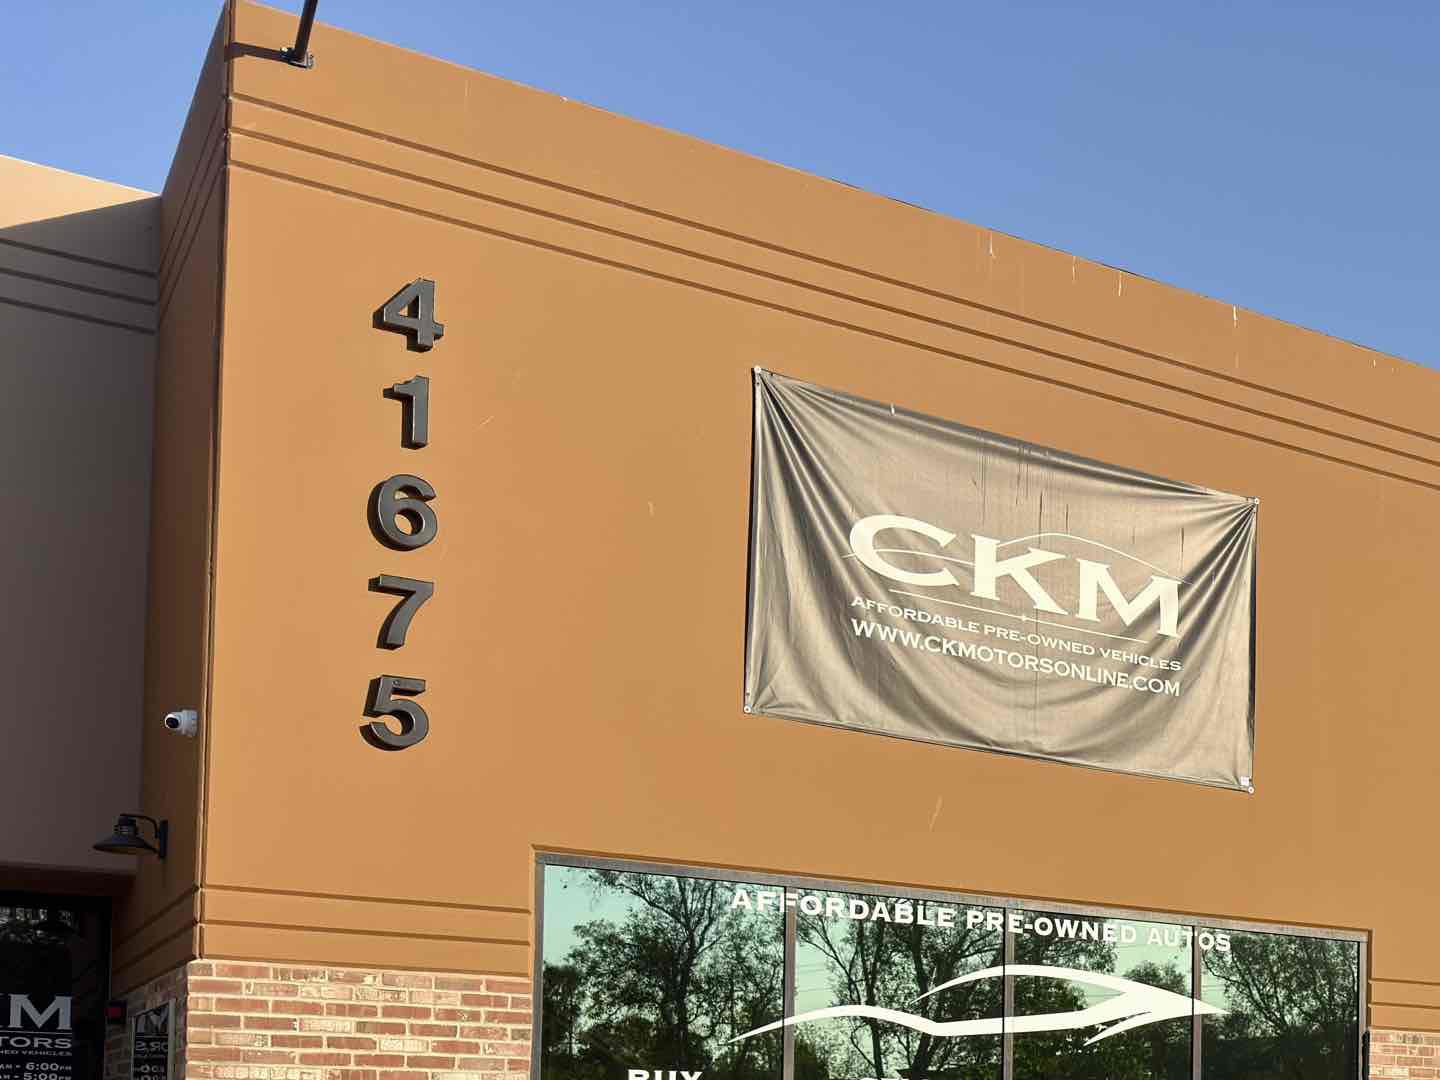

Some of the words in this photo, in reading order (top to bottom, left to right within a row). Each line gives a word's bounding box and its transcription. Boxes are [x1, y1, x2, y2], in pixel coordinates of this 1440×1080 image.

[359, 277, 445, 752] 41675
[848, 513, 1183, 638] CKM
[850, 596, 980, 634] AFFORDABLE
[984, 625, 1095, 657] PRE-OWNED
[1099, 646, 1183, 672] VEHICLES
[850, 617, 1181, 698] WWW.CKMOTORSONLINE.COM
[730, 887, 956, 928] AFFORDABLE
[966, 909, 1138, 943] PRE-OWNED
[1146, 926, 1231, 952] AUTOS
[0, 993, 72, 1030] M
